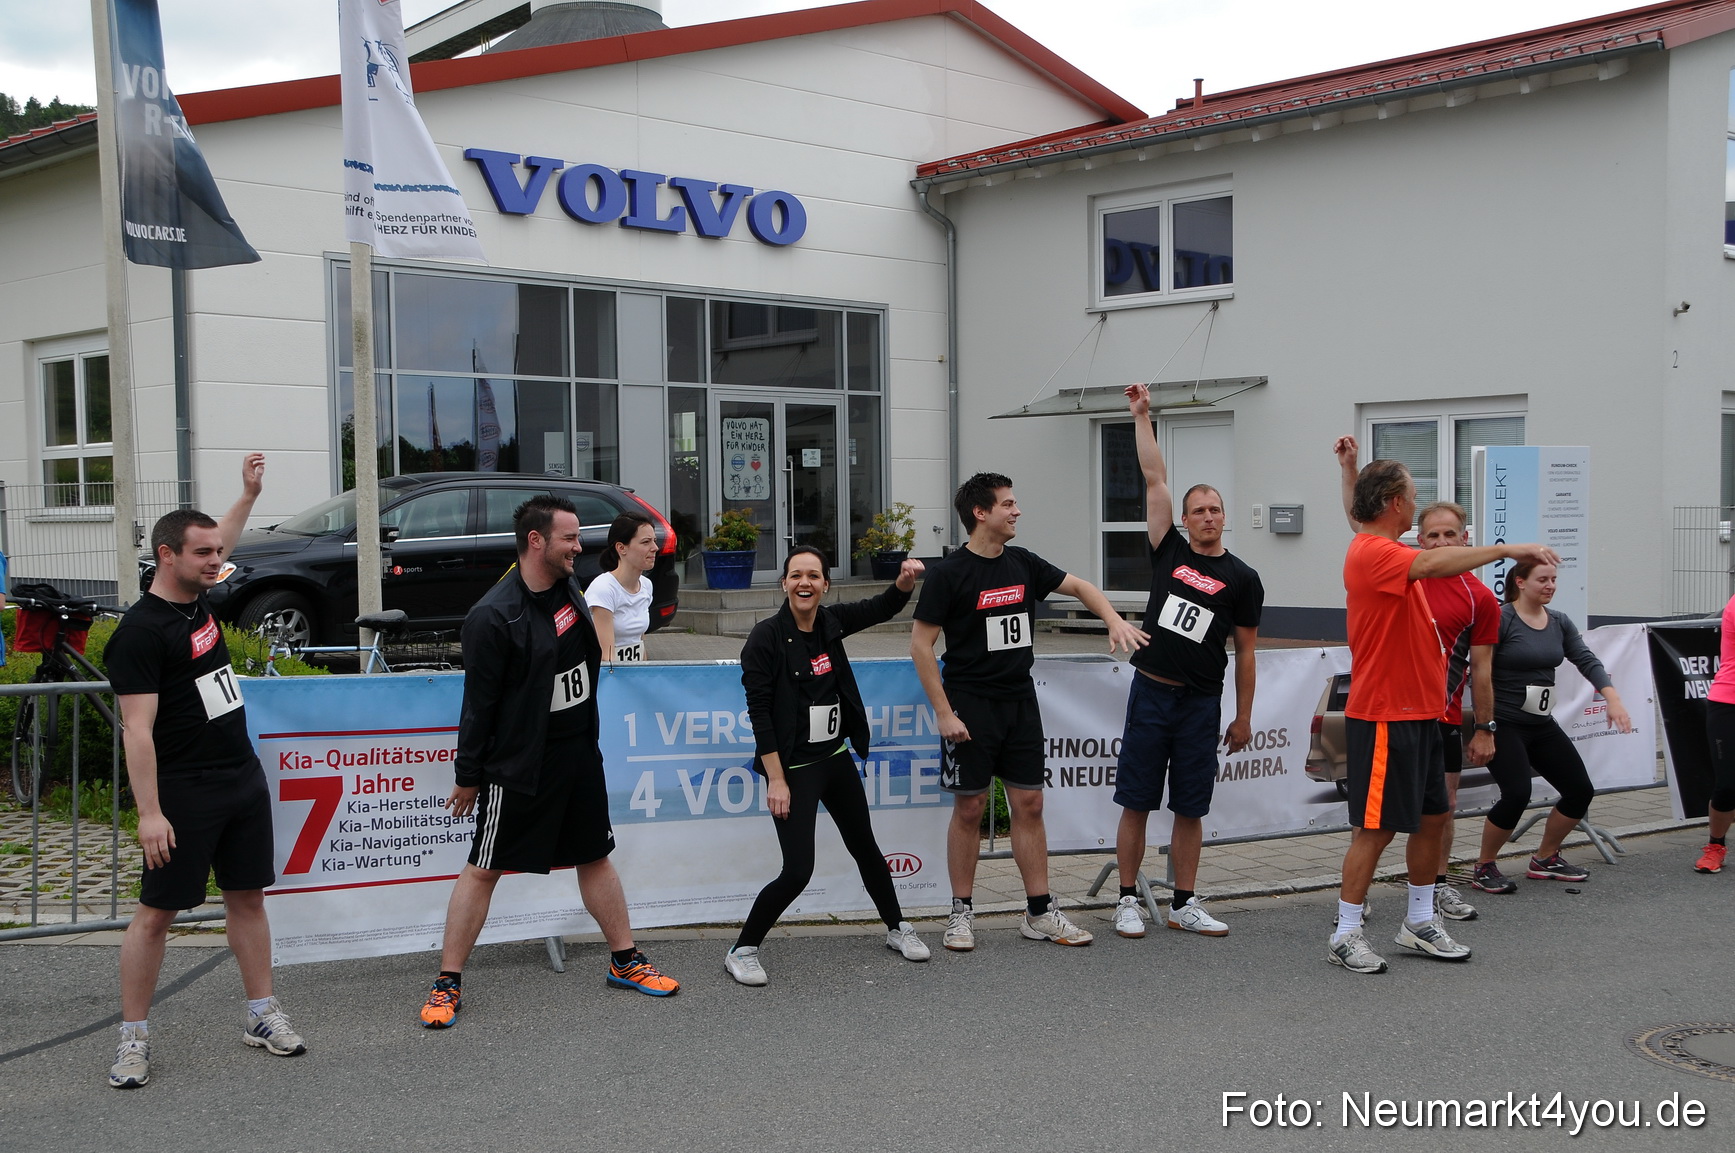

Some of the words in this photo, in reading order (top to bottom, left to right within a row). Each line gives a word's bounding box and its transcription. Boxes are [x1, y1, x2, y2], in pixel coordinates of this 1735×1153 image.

[465, 148, 807, 246] VOLVO
[376, 211, 461, 226] Spendenpartner
[377, 225, 408, 235] HERZ
[411, 223, 438, 235] FÜR
[1672, 350, 1679, 369] 2
[726, 420, 747, 431] VOLVO
[749, 420, 763, 431] HAT
[745, 431, 765, 441] HERZ
[403, 566, 423, 574] sports
[982, 588, 1021, 606] Franek
[1172, 601, 1201, 633] 16
[1000, 615, 1021, 645] 19
[1678, 655, 1709, 676] DER
[213, 667, 238, 705] 17
[561, 667, 584, 703] 18
[1538, 688, 1550, 712] 8
[1583, 704, 1607, 716] SEA
[623, 712, 637, 747] 1
[827, 706, 838, 735] 6
[279, 747, 458, 770] Kia-Qualitätsver
[629, 770, 663, 818] 4
[279, 775, 344, 875] 7
[352, 773, 415, 795] Jahre
[339, 813, 476, 834] Kia-Mobilitätsgara
[330, 829, 476, 852] Kia-Navigationskart
[886, 858, 914, 873] KIA
[908, 881, 937, 890] Surprise
